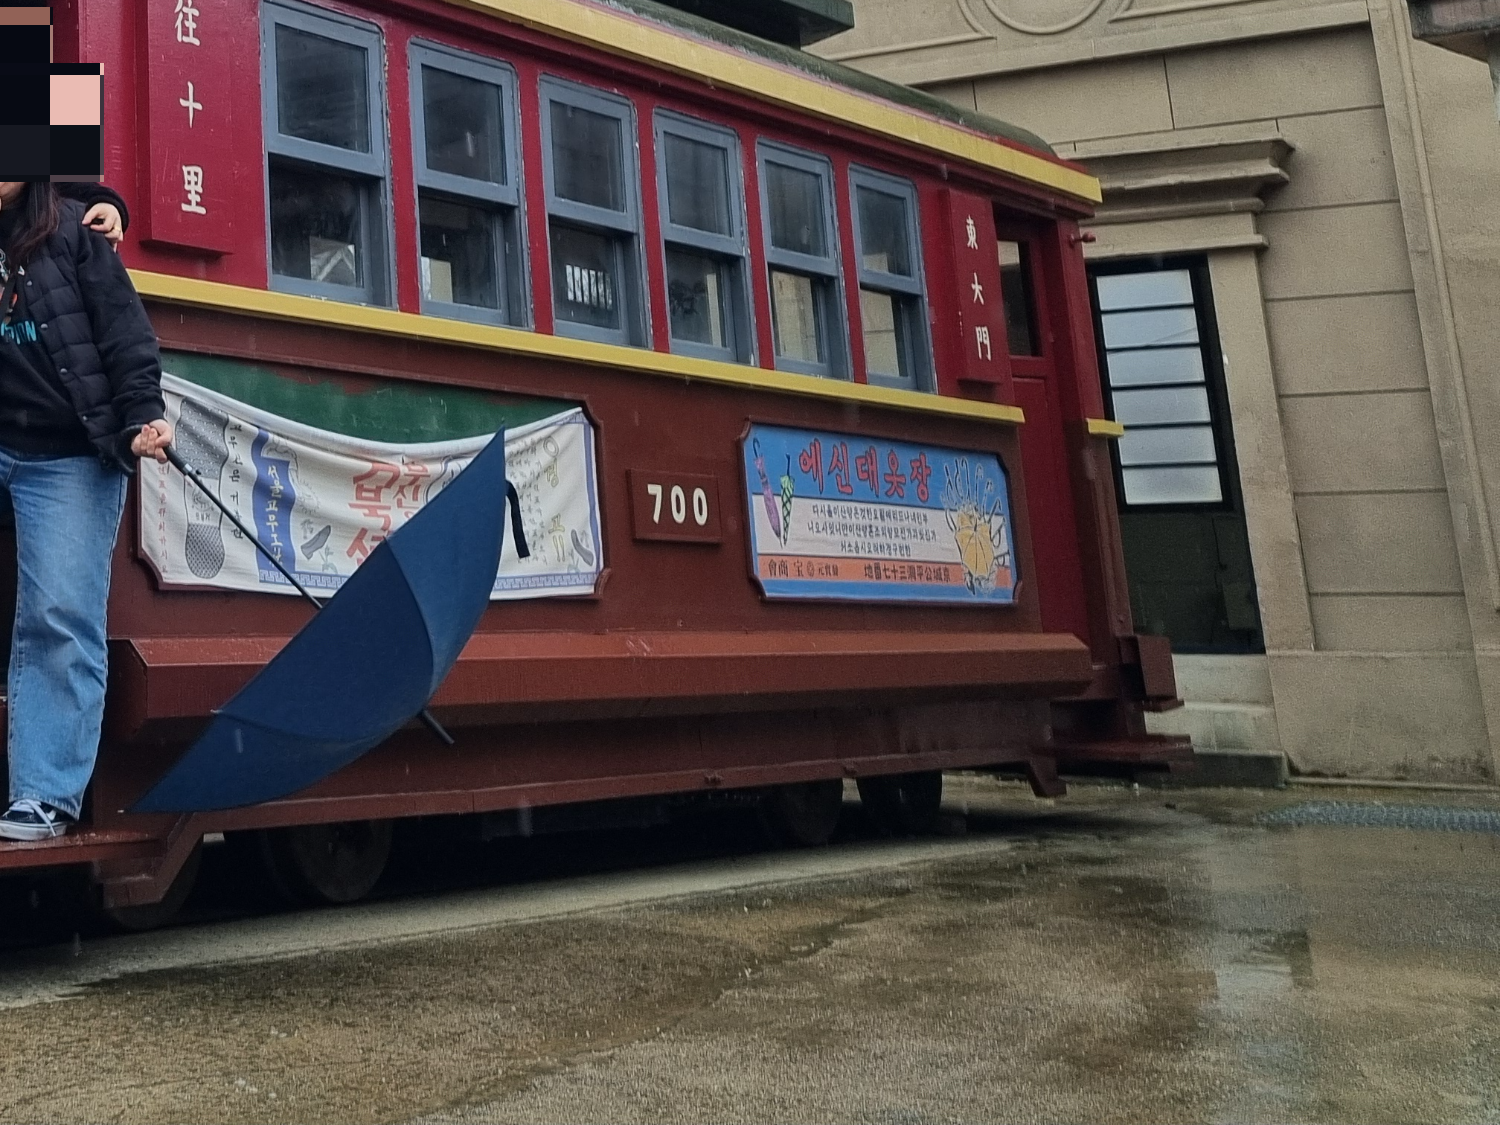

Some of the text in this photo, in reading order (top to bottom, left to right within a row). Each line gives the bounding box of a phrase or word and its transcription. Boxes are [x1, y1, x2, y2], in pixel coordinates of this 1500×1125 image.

[965, 215, 992, 361] 東大門
[647, 483, 708, 527] 700
